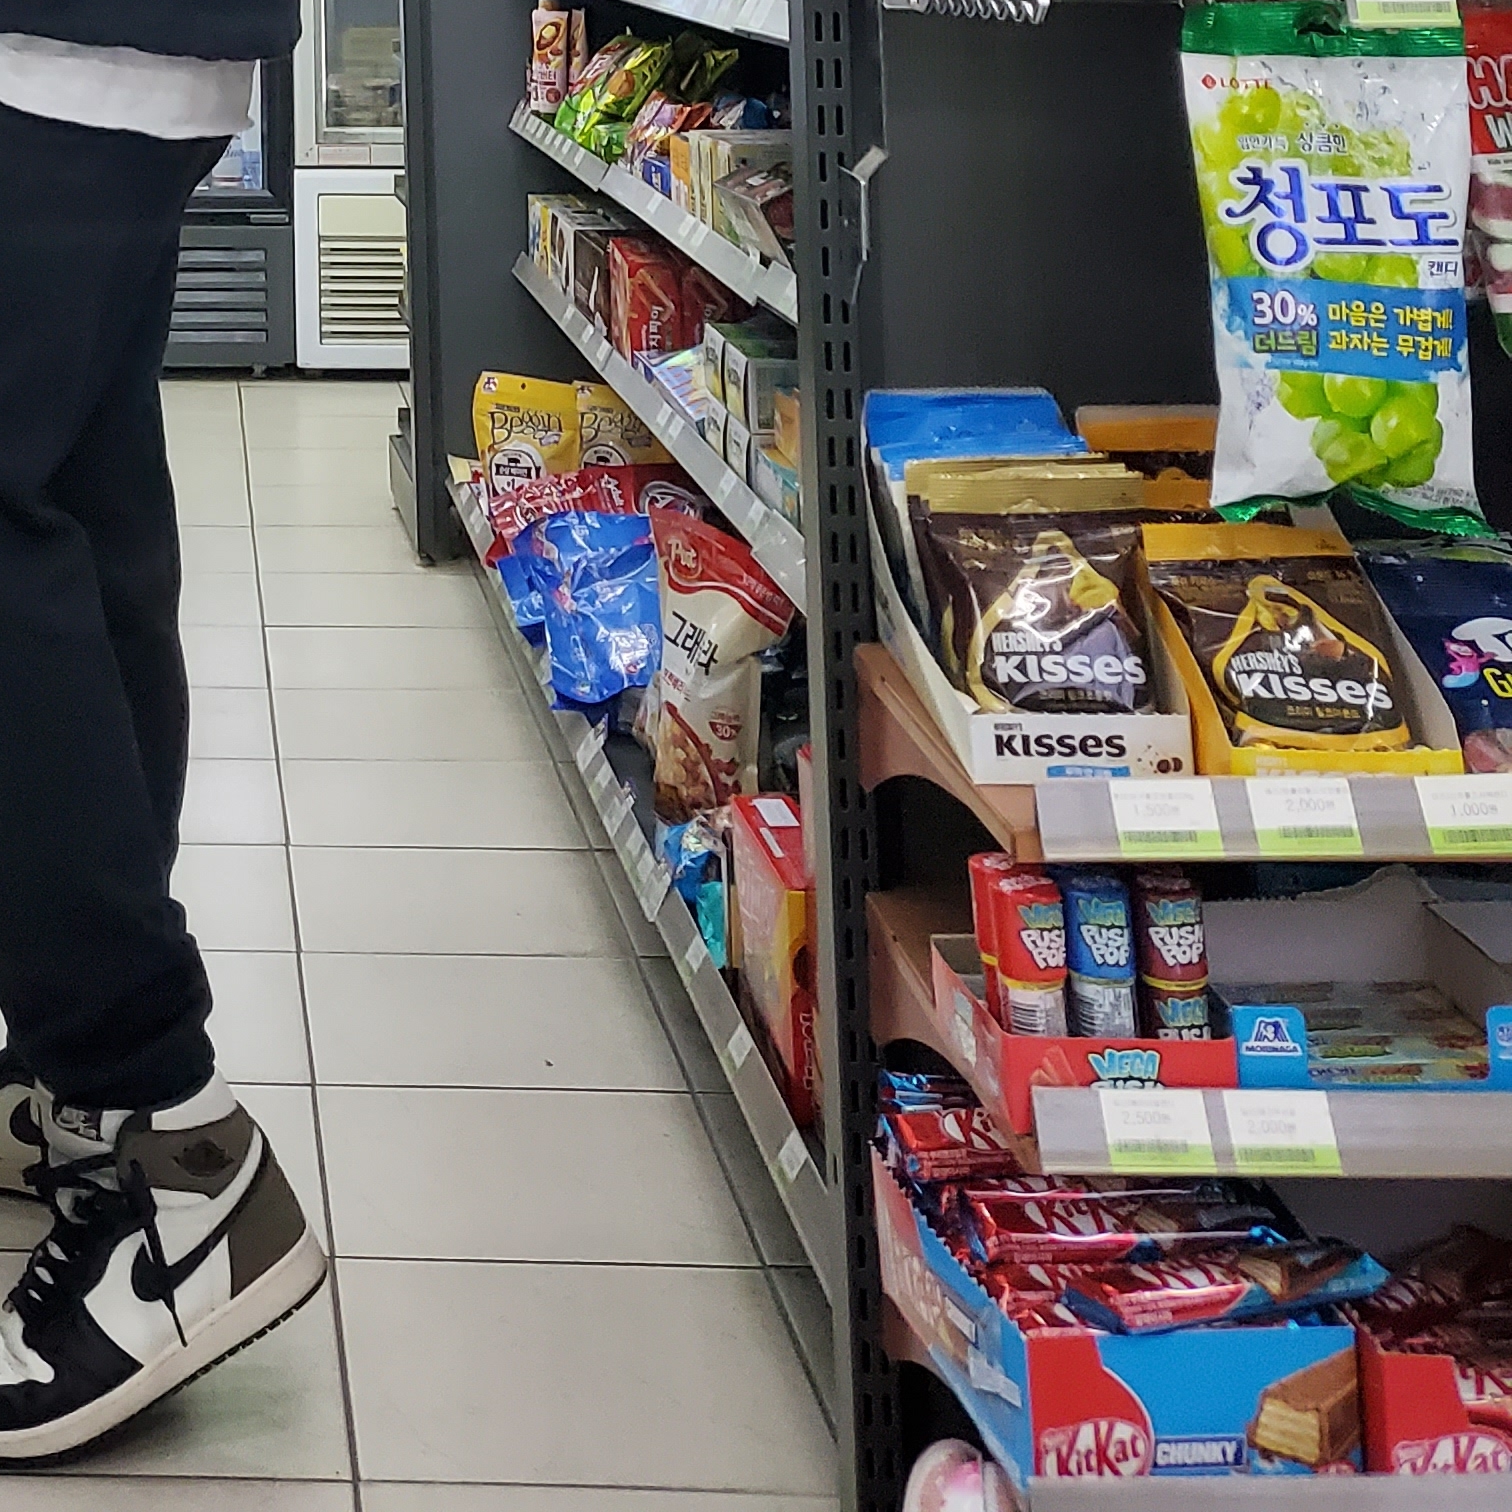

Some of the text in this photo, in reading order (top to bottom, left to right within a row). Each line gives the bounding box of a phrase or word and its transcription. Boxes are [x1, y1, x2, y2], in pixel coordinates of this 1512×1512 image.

[1296, 132, 1347, 154] 상큼한
[1225, 166, 1460, 267] 청포도
[1428, 260, 1459, 276] 캔디
[1252, 290, 1318, 326] 30%
[1327, 301, 1388, 329] 마음은
[1254, 330, 1318, 356] 더드림
[1327, 331, 1391, 357] 과자는
[1148, 925, 1204, 948] PUSH
[1160, 943, 1204, 966] POP
[1156, 1441, 1237, 1465] CHUNKY
